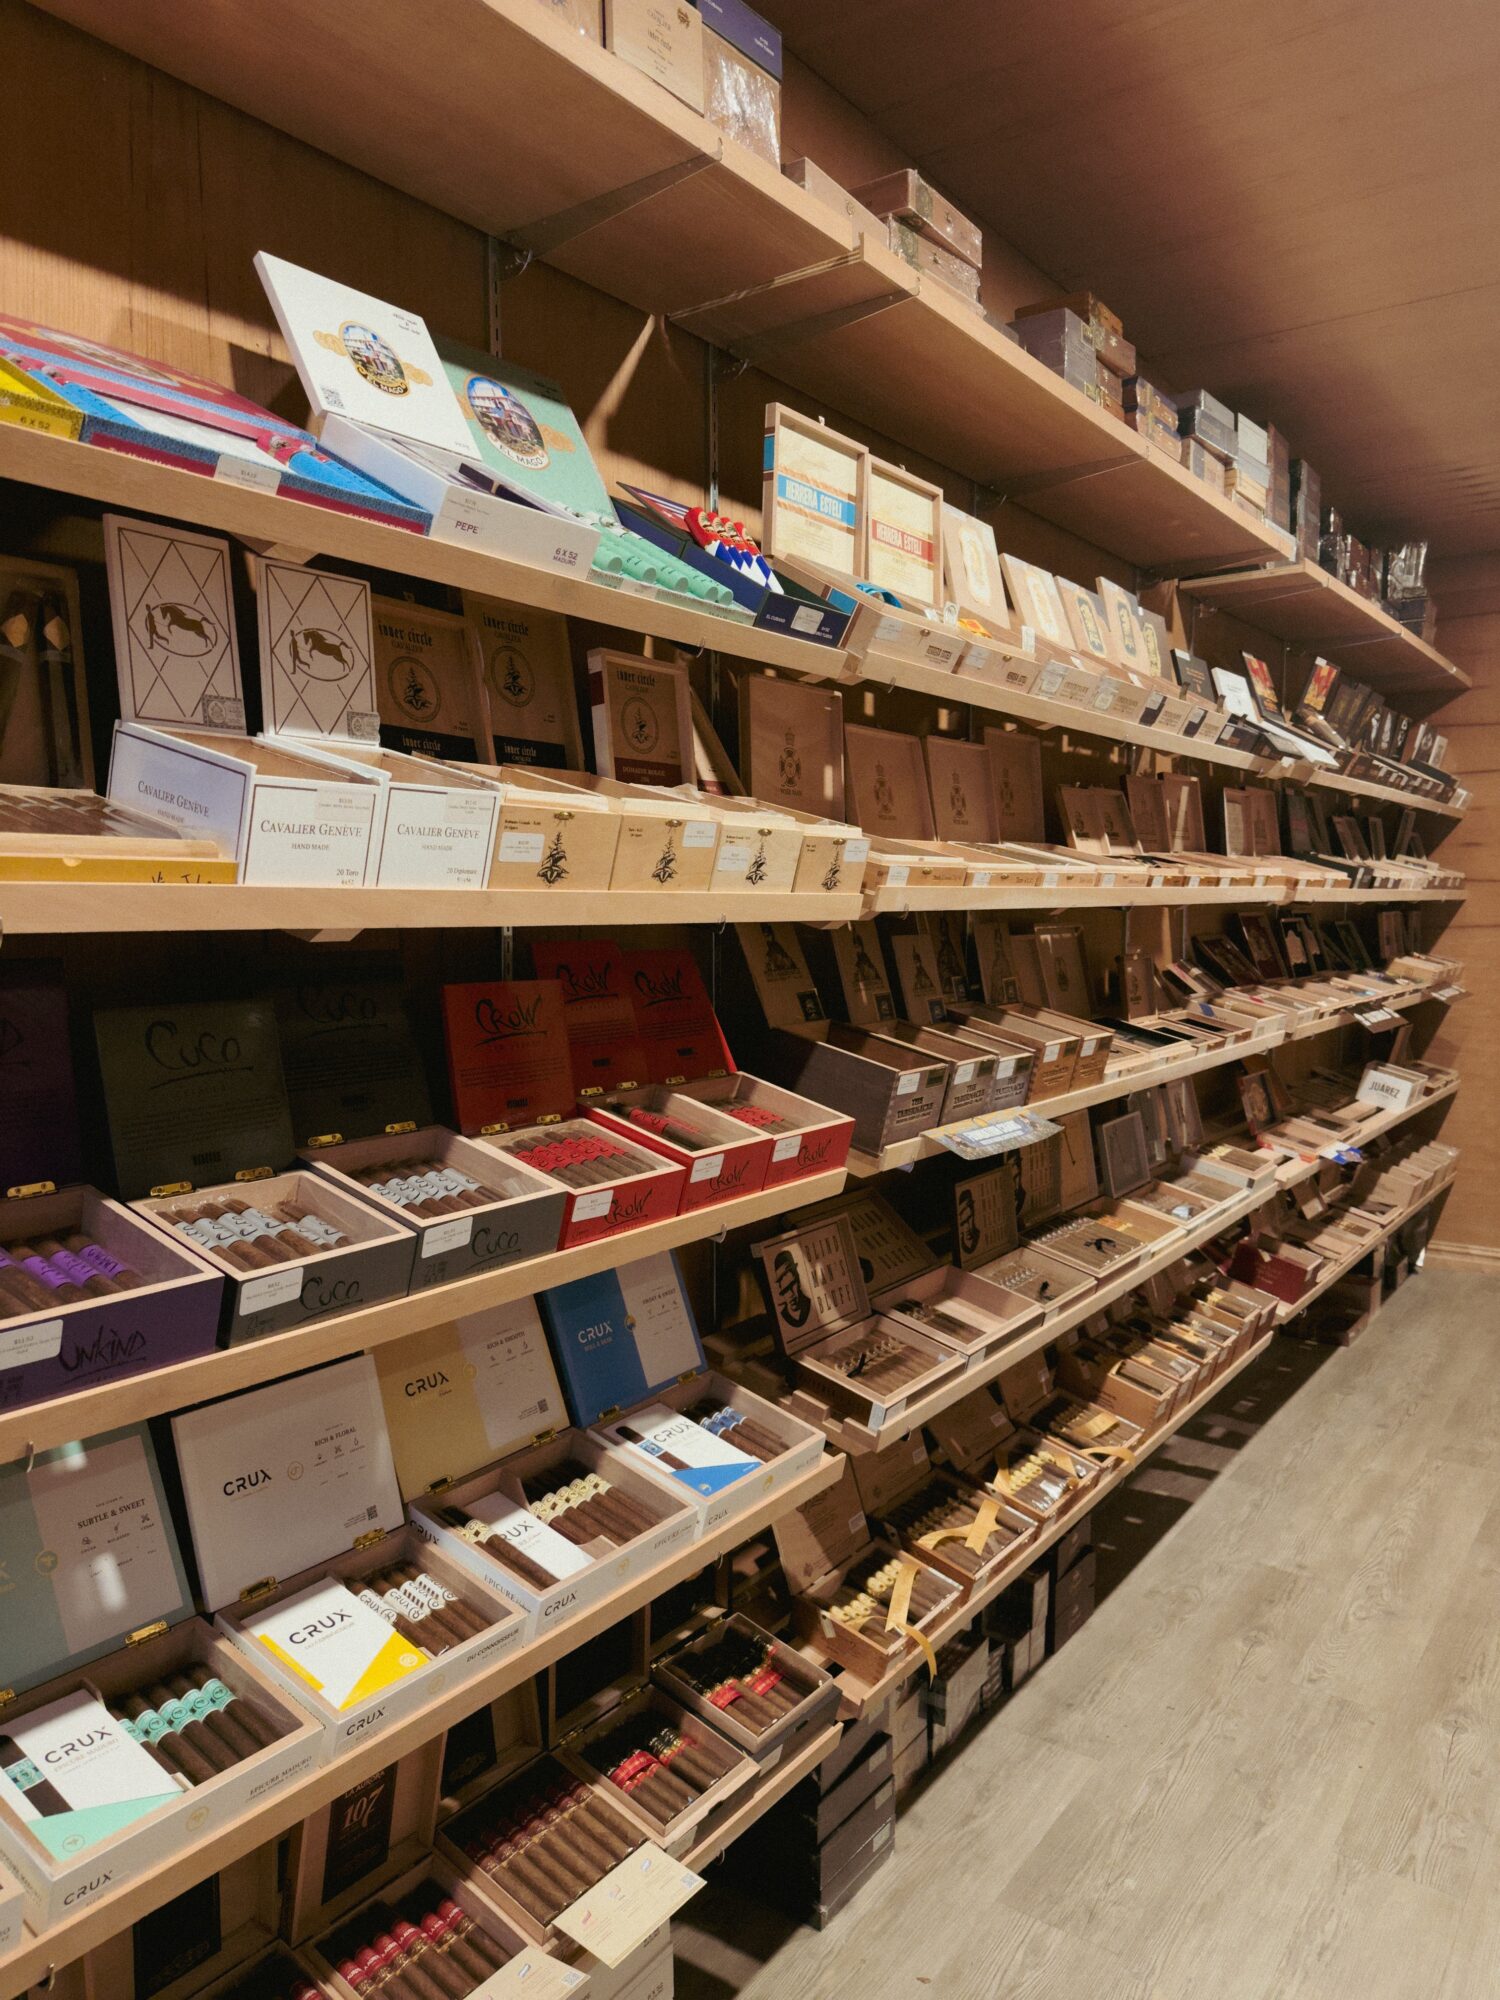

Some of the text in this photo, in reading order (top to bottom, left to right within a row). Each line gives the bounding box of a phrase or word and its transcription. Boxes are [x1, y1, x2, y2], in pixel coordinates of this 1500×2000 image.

[515, 453, 544, 467] MAGO
[785, 478, 818, 510] HERRERA
[454, 519, 480, 536] PEPE
[876, 520, 903, 550] HERRERA
[555, 547, 562, 556] 6
[568, 551, 579, 562] 52
[377, 620, 433, 648] inner circle
[483, 612, 529, 637] inner circle
[616, 668, 656, 687] inner circle
[137, 780, 176, 806] CAVALIER
[260, 819, 363, 839] CAVALIER GENÈVE
[397, 823, 443, 839] CAVALIER
[291, 842, 330, 852] HAND MADE
[336, 868, 345, 876] 20
[804, 1234, 840, 1263] BLIND
[811, 1258, 848, 1290] MAN'S
[817, 1283, 853, 1315] BLUFF
[577, 1320, 614, 1344] CRUX
[404, 1371, 450, 1398] CRUX
[314, 1436, 329, 1448] RICH
[335, 1426, 357, 1439] FLORAL
[653, 1420, 696, 1444] CRUX
[222, 1468, 273, 1497] CRUX
[77, 1498, 147, 1530] SUBTLE & SWEET
[708, 1509, 729, 1526] CRUX
[502, 1520, 536, 1542] RUX
[389, 1590, 411, 1612] CRUX
[484, 1573, 515, 1602] EPICURE
[359, 1593, 382, 1615] CRUX
[544, 1590, 578, 1618] CRUX
[289, 1608, 353, 1645] CRUX
[466, 1653, 479, 1663] DU
[476, 1627, 520, 1656] CONNOISSEUR
[345, 1705, 387, 1737] CRUX
[44, 1725, 113, 1765] CRUX
[249, 1754, 313, 1796] EPICURE MADURO
[342, 1783, 386, 1831] 107
[63, 1869, 113, 1907] CRUX
